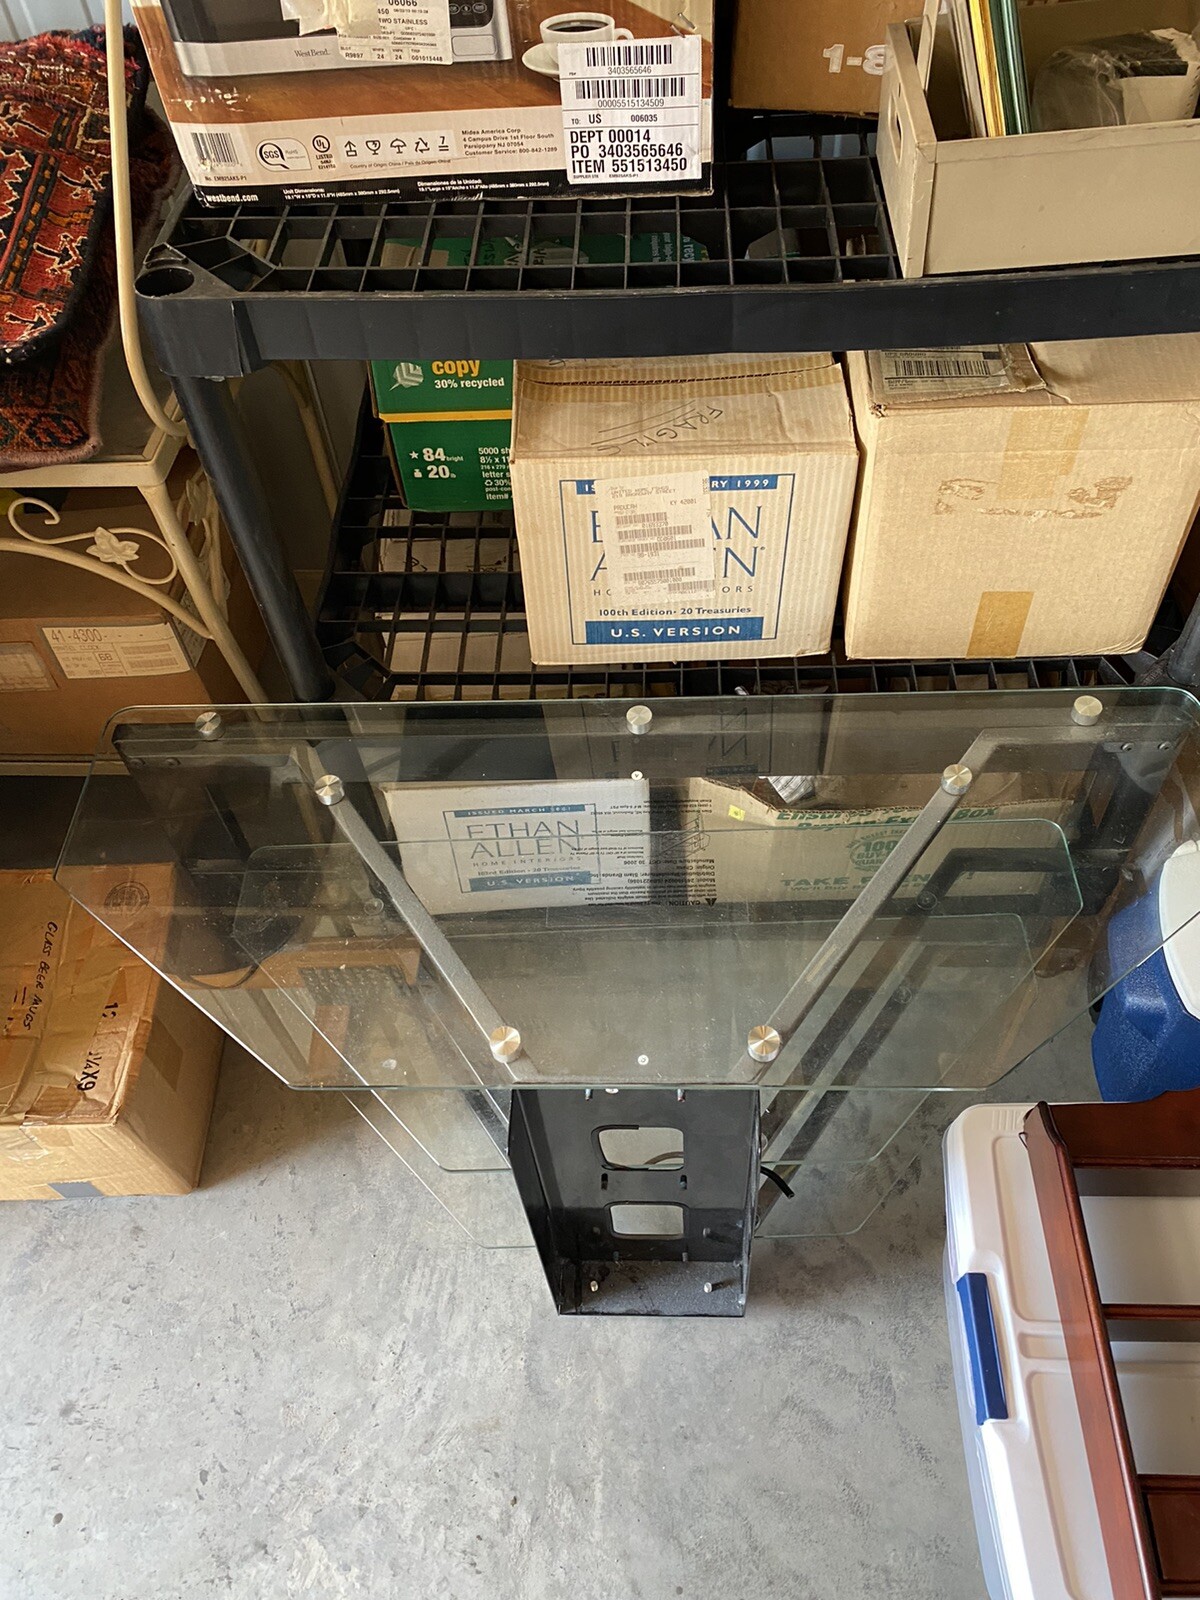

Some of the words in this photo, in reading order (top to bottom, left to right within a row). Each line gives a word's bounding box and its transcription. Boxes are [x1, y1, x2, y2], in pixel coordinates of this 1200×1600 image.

[607, 66, 652, 75] 3403565646
[588, 113, 602, 124] US
[630, 114, 658, 123] 006035
[570, 130, 604, 144] DEPT
[608, 129, 651, 143] 00014
[263, 149, 280, 160] SGS
[571, 145, 590, 159] PO
[598, 142, 684, 159] 3403565646
[572, 159, 605, 174] ITEM
[612, 157, 688, 173] 551513450
[206, 194, 258, 203] westbend.com
[431, 360, 481, 378] copy
[434, 379, 458, 389] 30%
[460, 377, 505, 389] recycled
[422, 447, 446, 462] 84
[478, 447, 499, 455] 5000
[427, 465, 450, 479] 20
[482, 470, 504, 478] letter
[737, 480, 770, 488] 1999
[599, 607, 629, 617] 100th
[680, 607, 693, 615] 20
[695, 605, 752, 615] Treasuries
[610, 628, 646, 638] U.S.
[652, 625, 742, 637] VERSION
[952, 808, 997, 821] BOX
[466, 820, 579, 838] ETHAN
[470, 838, 581, 860] ALLEN
[472, 860, 507, 868] HOME
[513, 856, 582, 865] INTERIORS
[515, 876, 575, 885] VERSION
[781, 876, 850, 887] TAKE
[42, 921, 59, 957] GLASS
[35, 961, 51, 990] BEER
[22, 994, 43, 1031] MUGS
